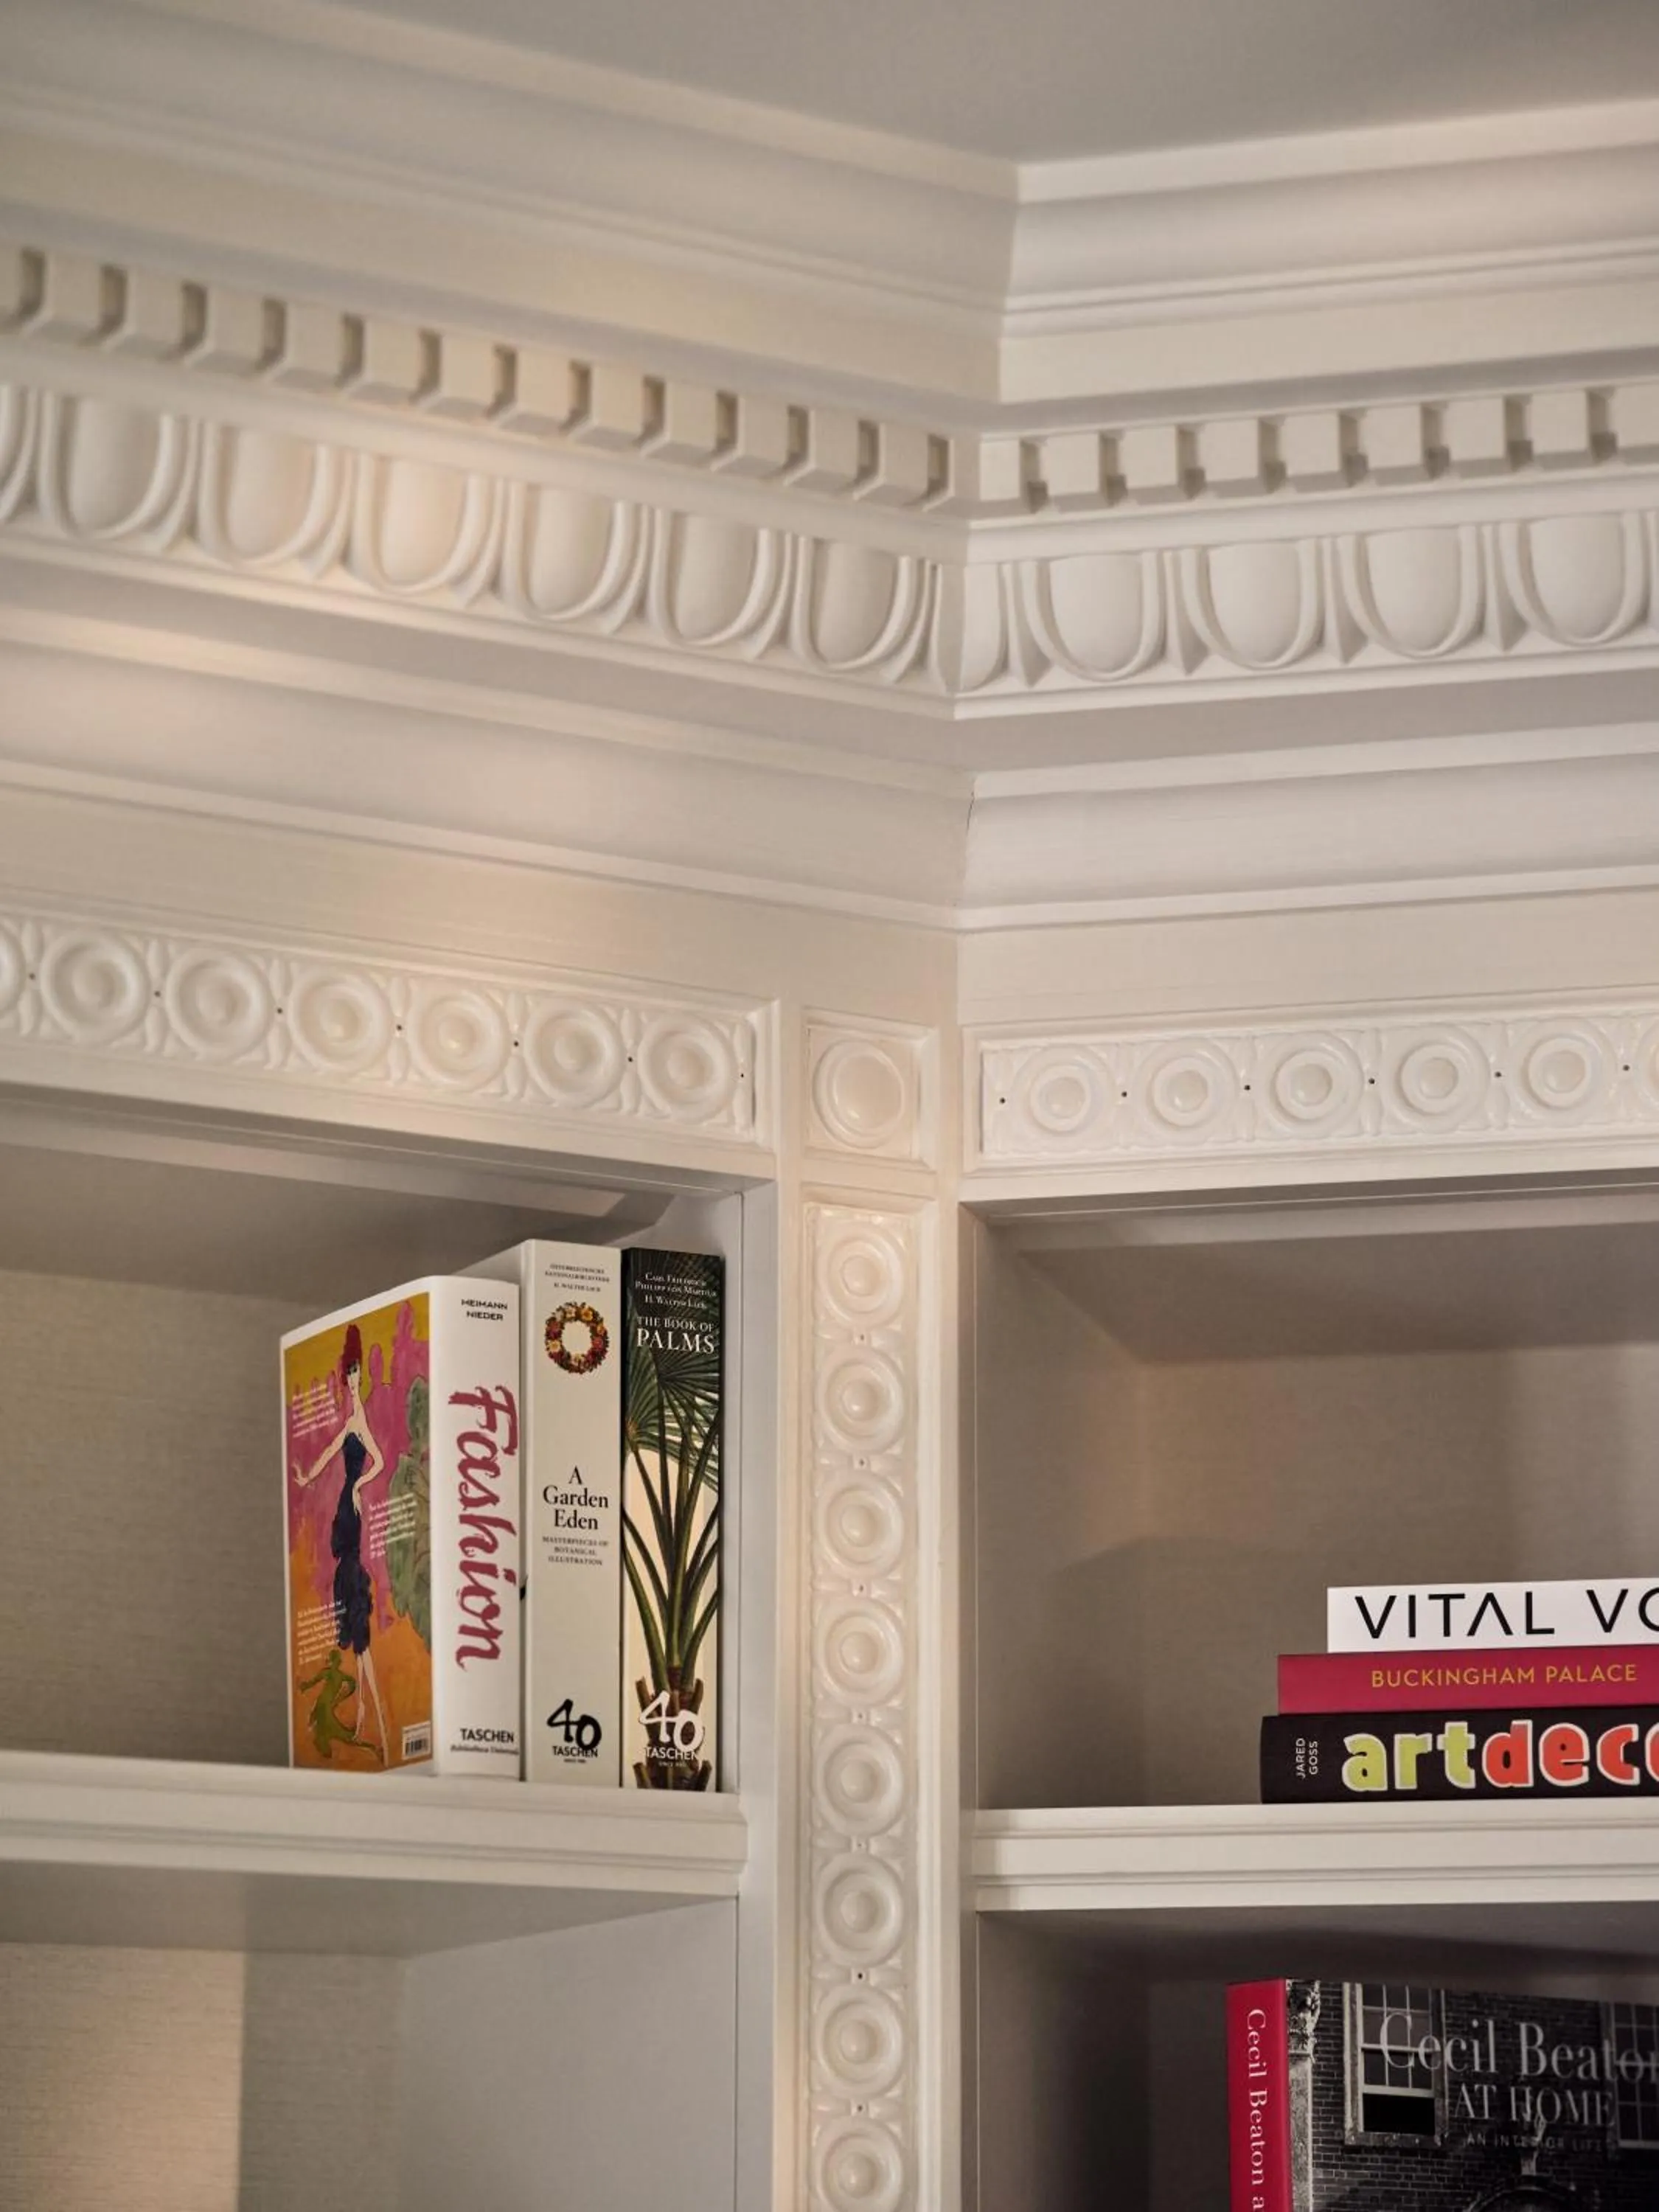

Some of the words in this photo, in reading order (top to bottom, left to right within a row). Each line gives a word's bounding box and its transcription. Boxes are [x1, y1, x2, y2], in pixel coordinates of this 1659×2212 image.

[636, 1327, 714, 1354] PALMS
[637, 1316, 660, 1326] THE
[664, 1318, 697, 1331] BOOK
[700, 1322, 714, 1332] OF
[568, 1465, 583, 1485] A
[543, 1484, 609, 1509] Garden
[448, 1385, 518, 1672] Fashion
[554, 1509, 599, 1530] Eden
[1354, 1591, 1556, 1639] VITAL
[1371, 1666, 1535, 1688] BUCKINGHAM
[1545, 1663, 1638, 1684] PALACE
[460, 1728, 515, 1743] TASCHEN
[546, 1698, 602, 1751] 40
[639, 1690, 705, 1752] 40
[552, 1745, 598, 1759] TASCHEN
[1295, 1738, 1306, 1780] JARED
[1309, 1741, 1318, 1775] GOSS
[1247, 2009, 1267, 2078] Cecil
[1380, 2012, 1498, 2073] Cecil
[1453, 2083, 1498, 2120] AT
[1509, 2086, 1615, 2127] HOME
[1249, 2090, 1268, 2185] Beaton
